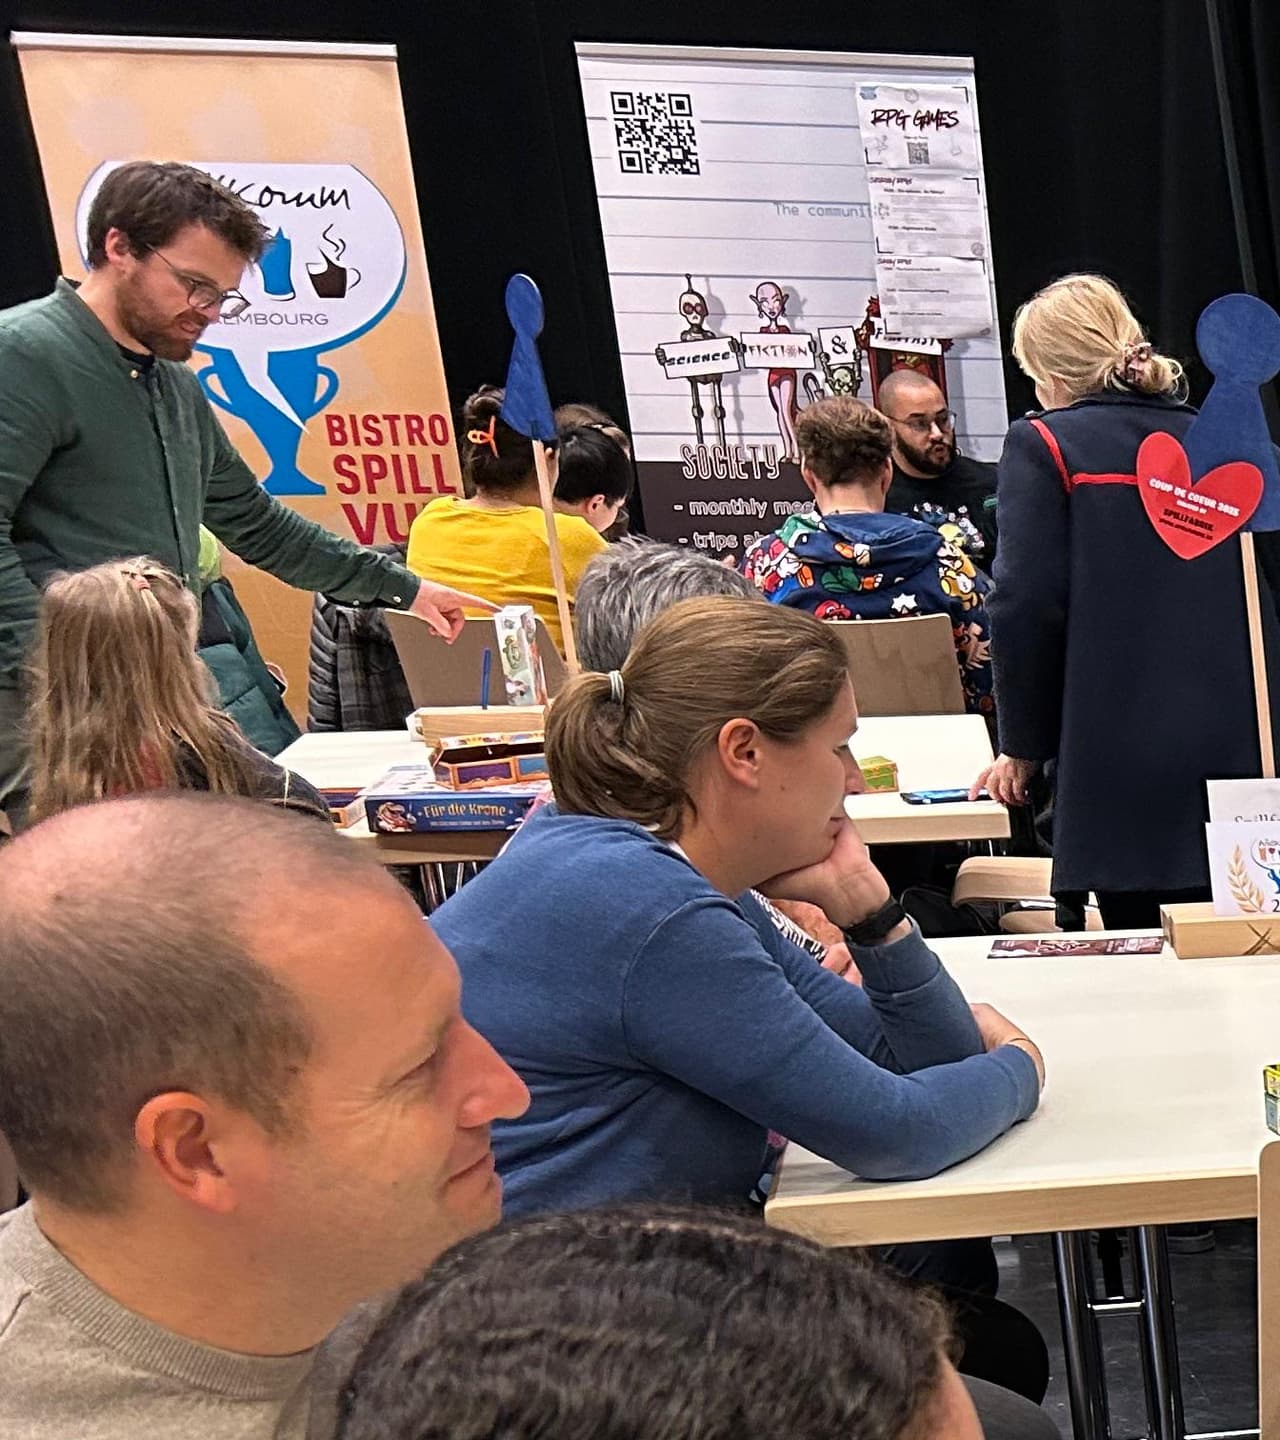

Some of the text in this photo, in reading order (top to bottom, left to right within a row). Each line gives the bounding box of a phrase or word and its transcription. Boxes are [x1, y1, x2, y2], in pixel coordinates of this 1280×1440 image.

[870, 108, 959, 131] RPG GAMES
[773, 201, 800, 217] The
[831, 335, 848, 355] &
[325, 414, 450, 447] BISTRO
[680, 444, 781, 480] SOCIETY
[333, 454, 457, 495] SPILL
[1149, 478, 1174, 493] COUP
[1174, 486, 1187, 499] DE
[689, 498, 768, 519] monthly
[693, 531, 739, 551] trips
[424, 804, 446, 818] Für
[448, 803, 465, 816] die
